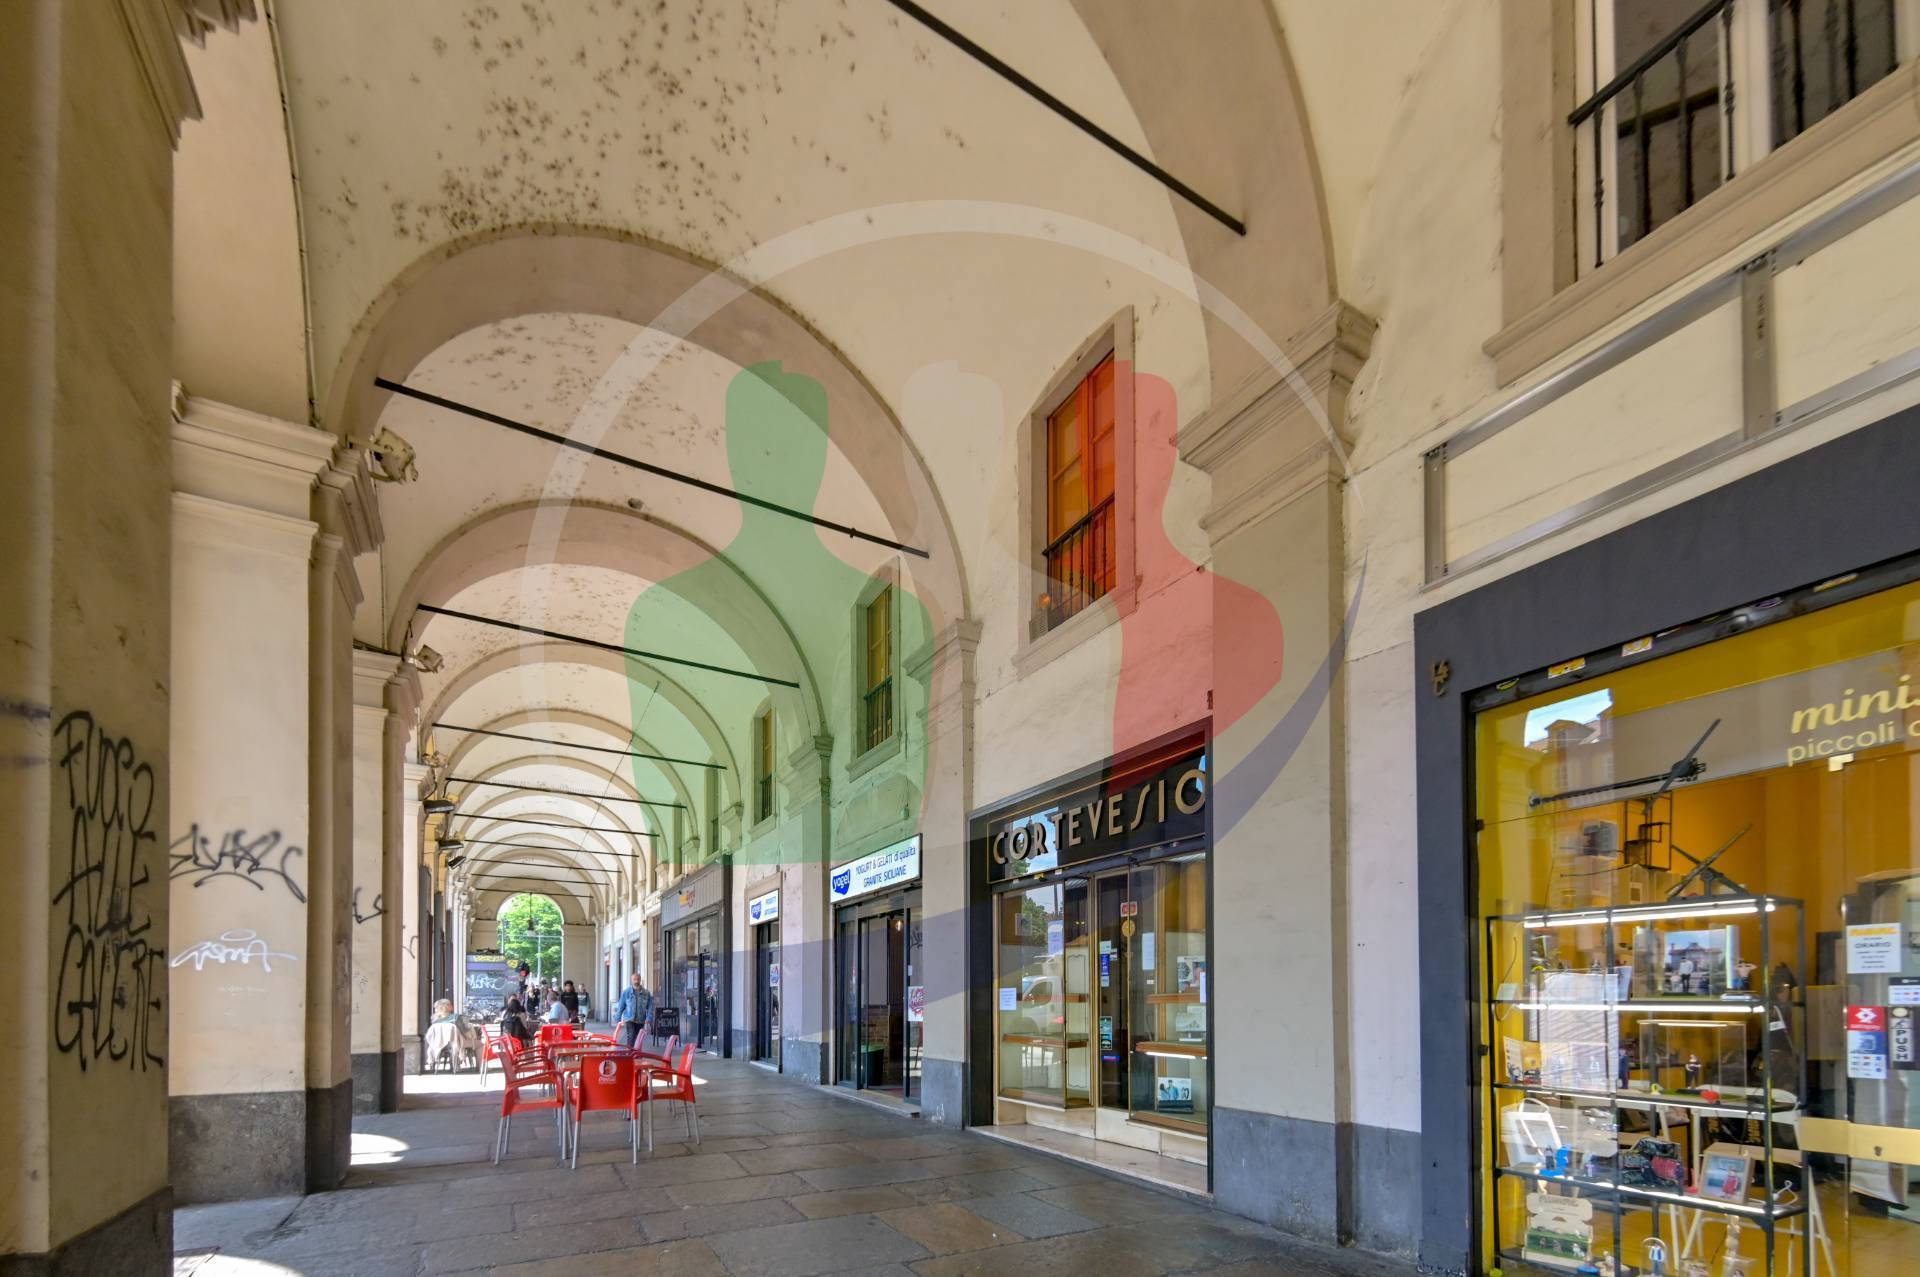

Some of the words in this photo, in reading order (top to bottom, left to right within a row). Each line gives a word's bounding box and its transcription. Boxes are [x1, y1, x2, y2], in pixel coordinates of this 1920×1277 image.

[1791, 674, 1920, 734] mini
[1787, 720, 1895, 767] piccoli
[993, 768, 1206, 865] CORTEVESIO
[856, 861, 873, 875] YOGURT
[876, 853, 893, 867] GELATI
[863, 872, 882, 888] GRANITE
[883, 864, 906, 882] SICILIANE
